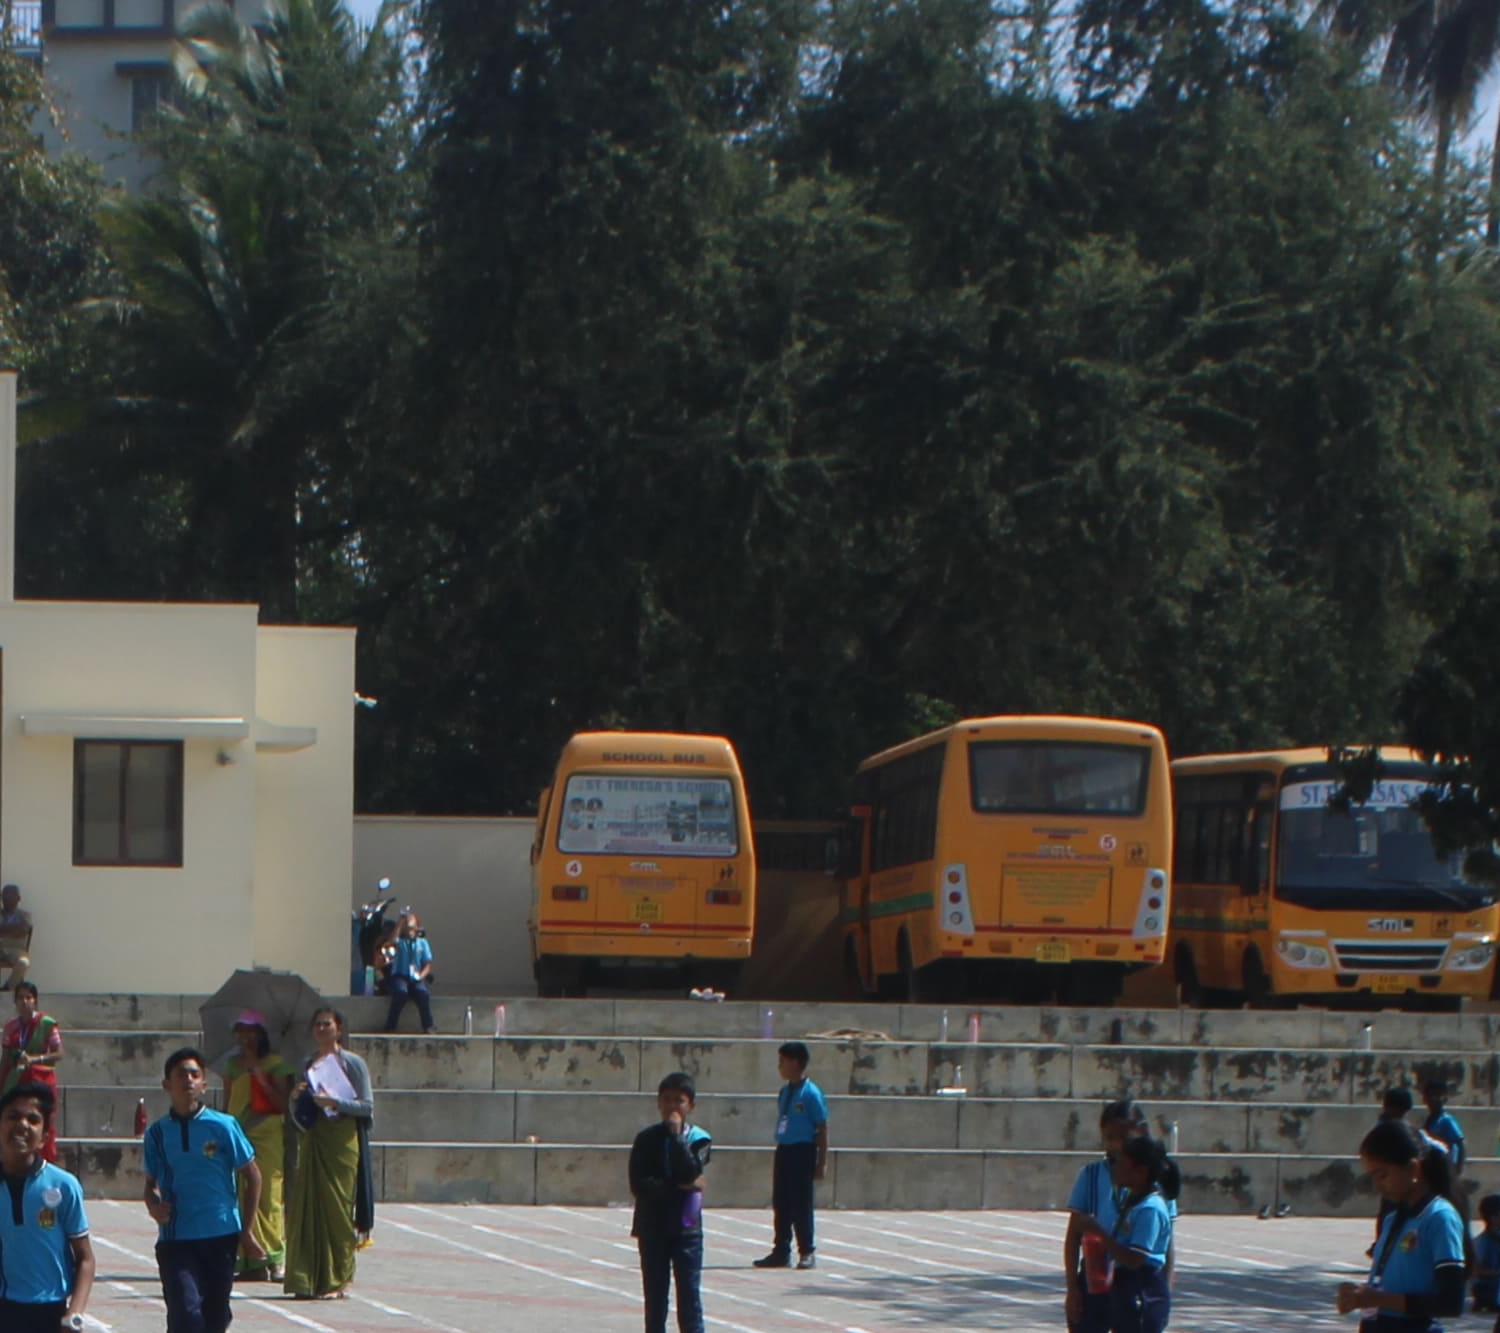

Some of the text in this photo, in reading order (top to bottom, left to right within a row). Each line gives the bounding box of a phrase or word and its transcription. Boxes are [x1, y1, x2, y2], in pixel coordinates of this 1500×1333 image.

[602, 752, 706, 764] SCHOOL BUS
[1103, 836, 1114, 850] 5
[568, 861, 580, 874] 4
